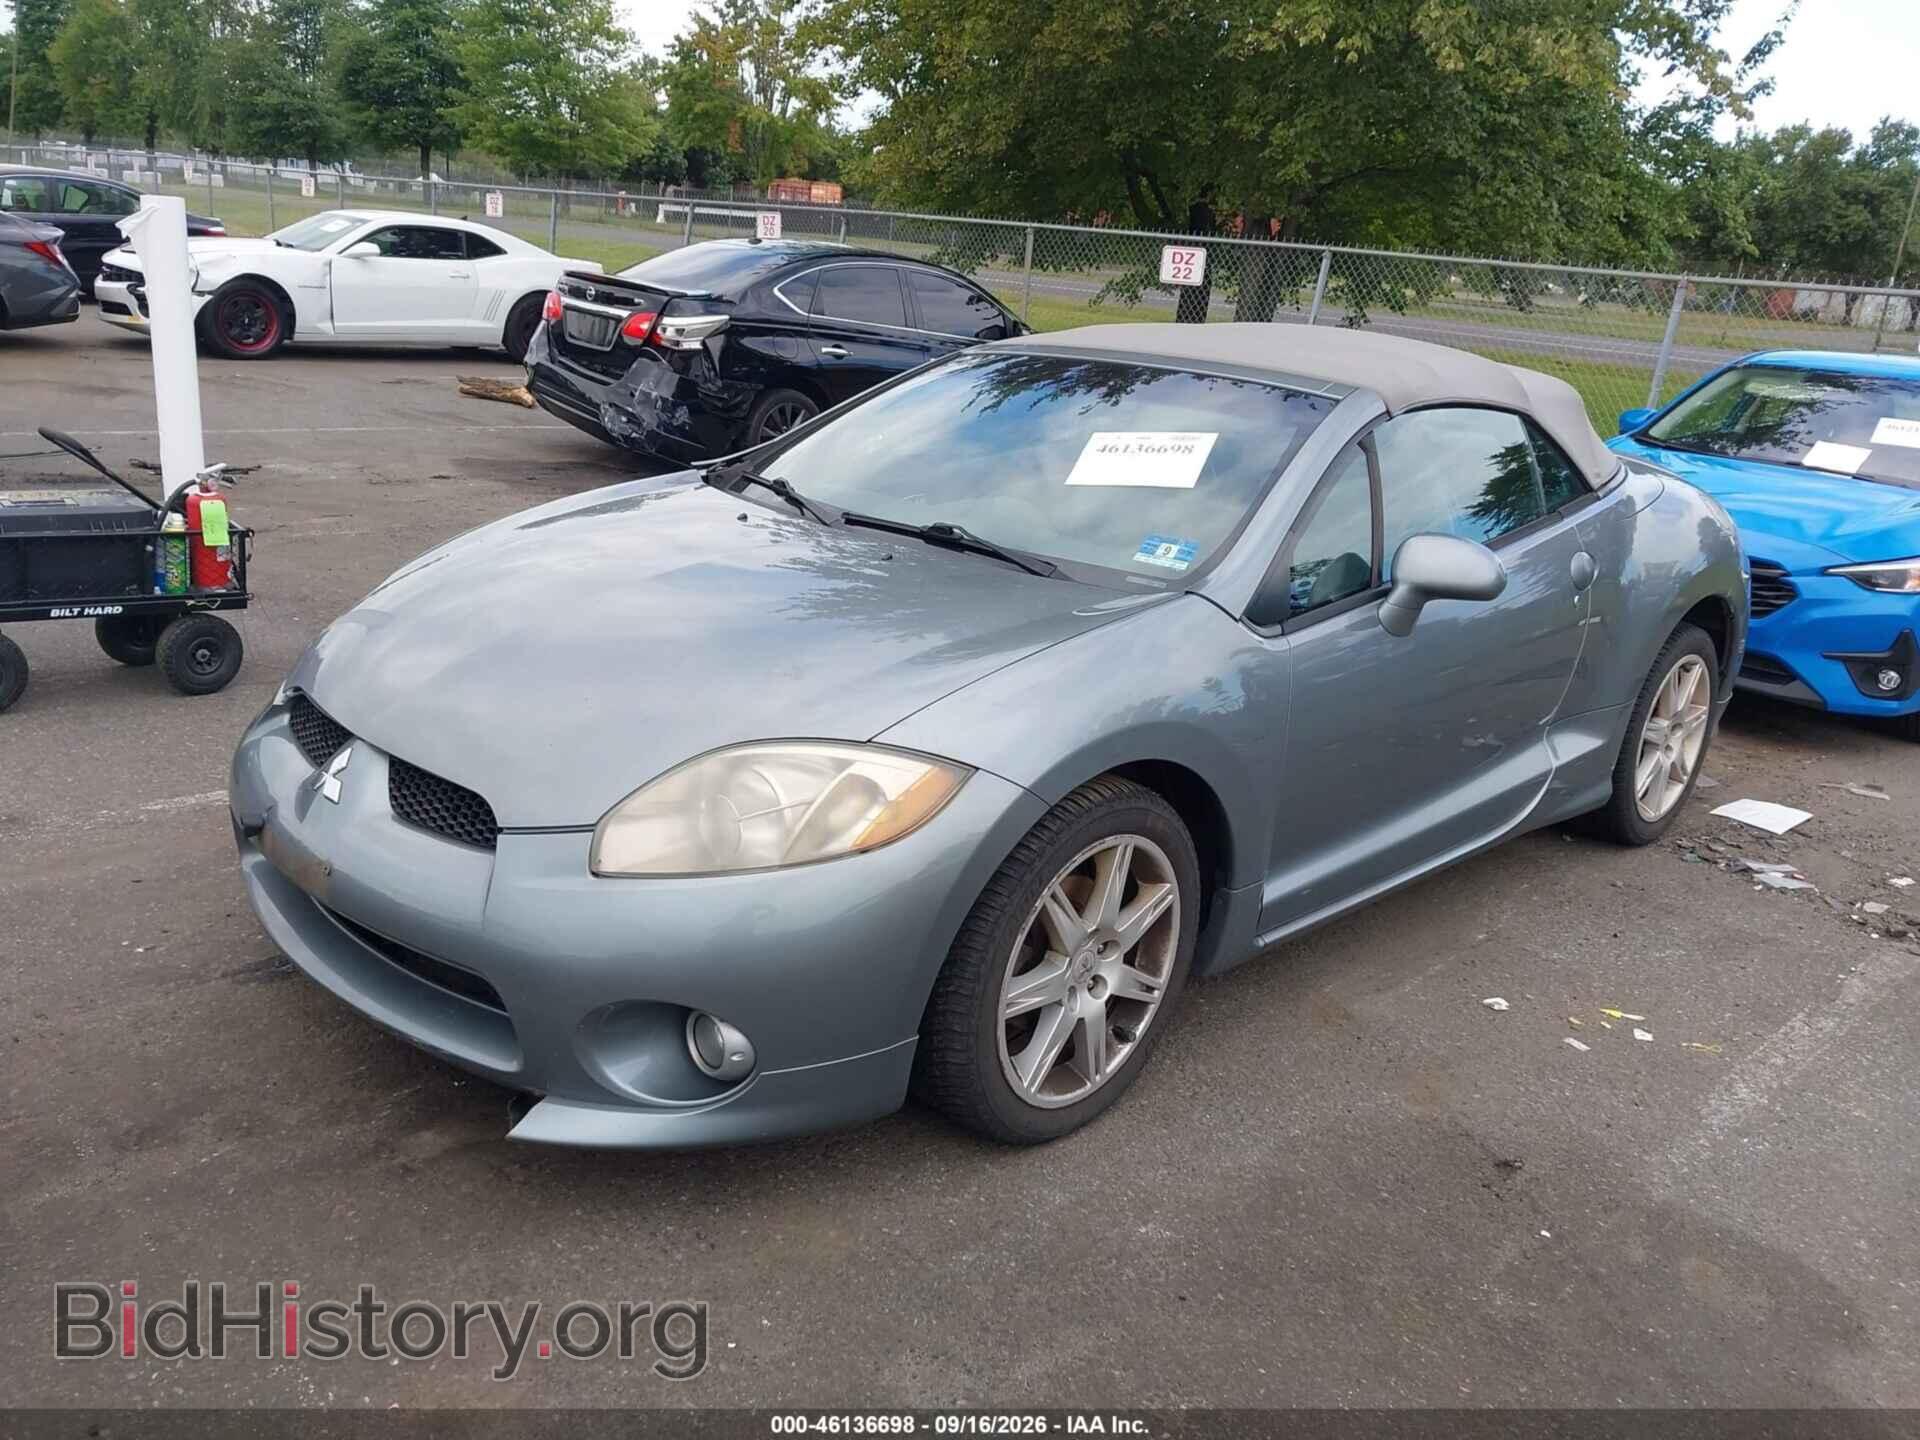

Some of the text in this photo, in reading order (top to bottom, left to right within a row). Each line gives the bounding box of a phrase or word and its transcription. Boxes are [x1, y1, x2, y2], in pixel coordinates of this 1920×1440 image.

[762, 215, 776, 226] DZ
[763, 226, 775, 237] 20
[1172, 251, 1196, 266] DZ
[1172, 266, 1193, 280] 22
[1162, 546, 1173, 556] 9
[50, 605, 123, 618] BILT HARD
